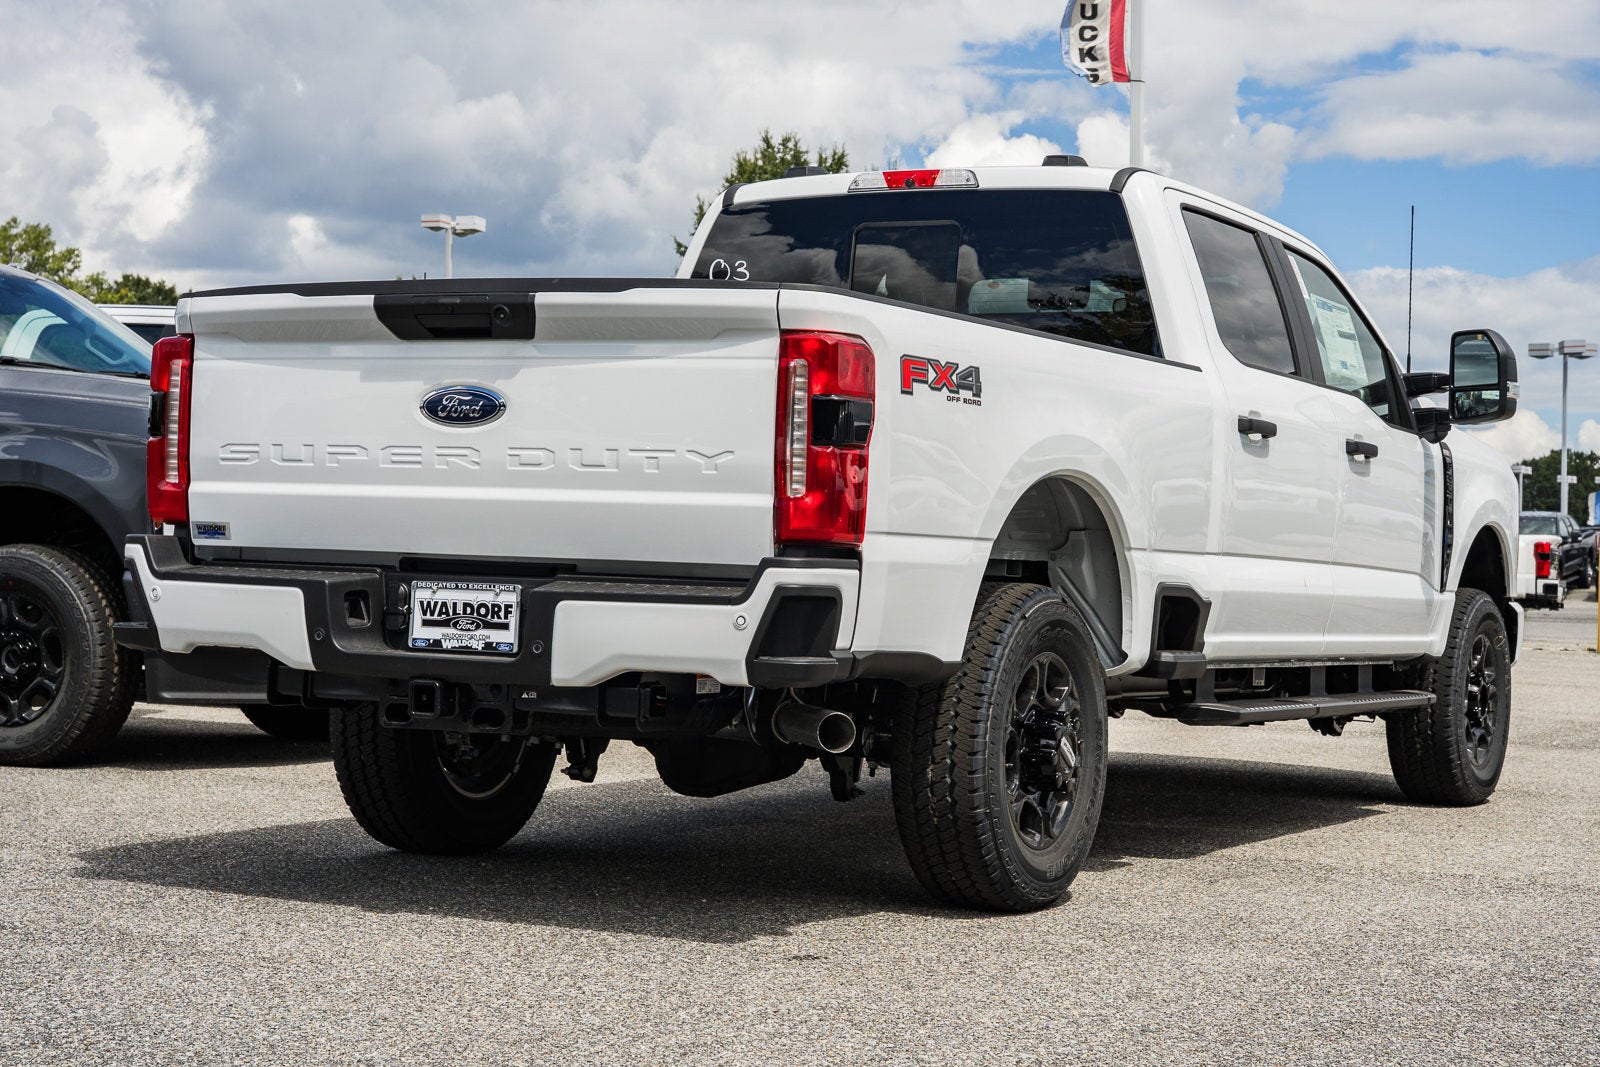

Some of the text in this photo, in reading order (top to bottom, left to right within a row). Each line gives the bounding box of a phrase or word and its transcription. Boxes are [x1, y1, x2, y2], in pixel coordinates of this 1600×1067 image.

[900, 354, 982, 398] FX4
[946, 395, 982, 406] OFF ROAD
[218, 441, 735, 474] SUPER DUTY
[469, 583, 514, 591] EXCELLENCE
[418, 600, 514, 620] WALDORF
[456, 619, 477, 630] Ford
[441, 639, 485, 651] WALDORF
